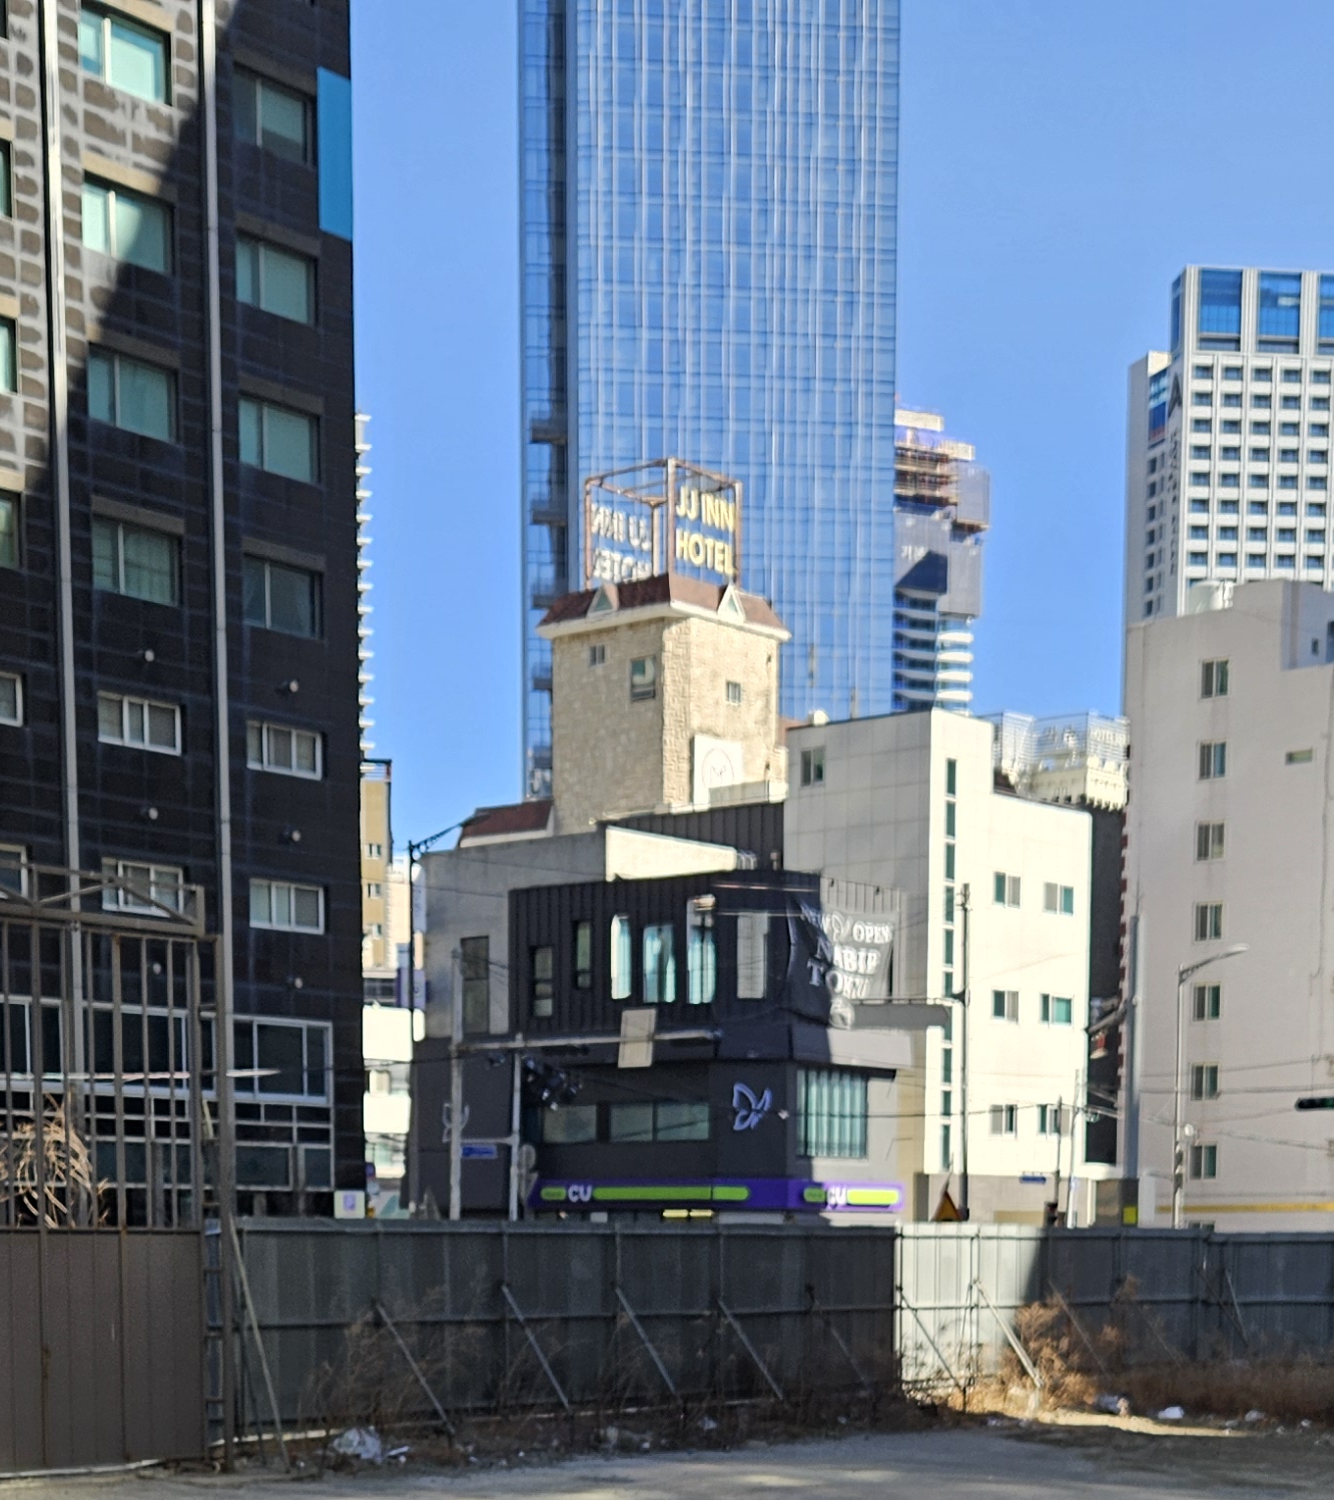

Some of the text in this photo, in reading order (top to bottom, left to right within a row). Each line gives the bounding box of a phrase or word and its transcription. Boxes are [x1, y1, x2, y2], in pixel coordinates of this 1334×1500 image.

[675, 484, 736, 533] JJ INN
[675, 527, 734, 577] HOTEL
[852, 919, 893, 944] OPEN
[567, 1184, 593, 1203] CU
